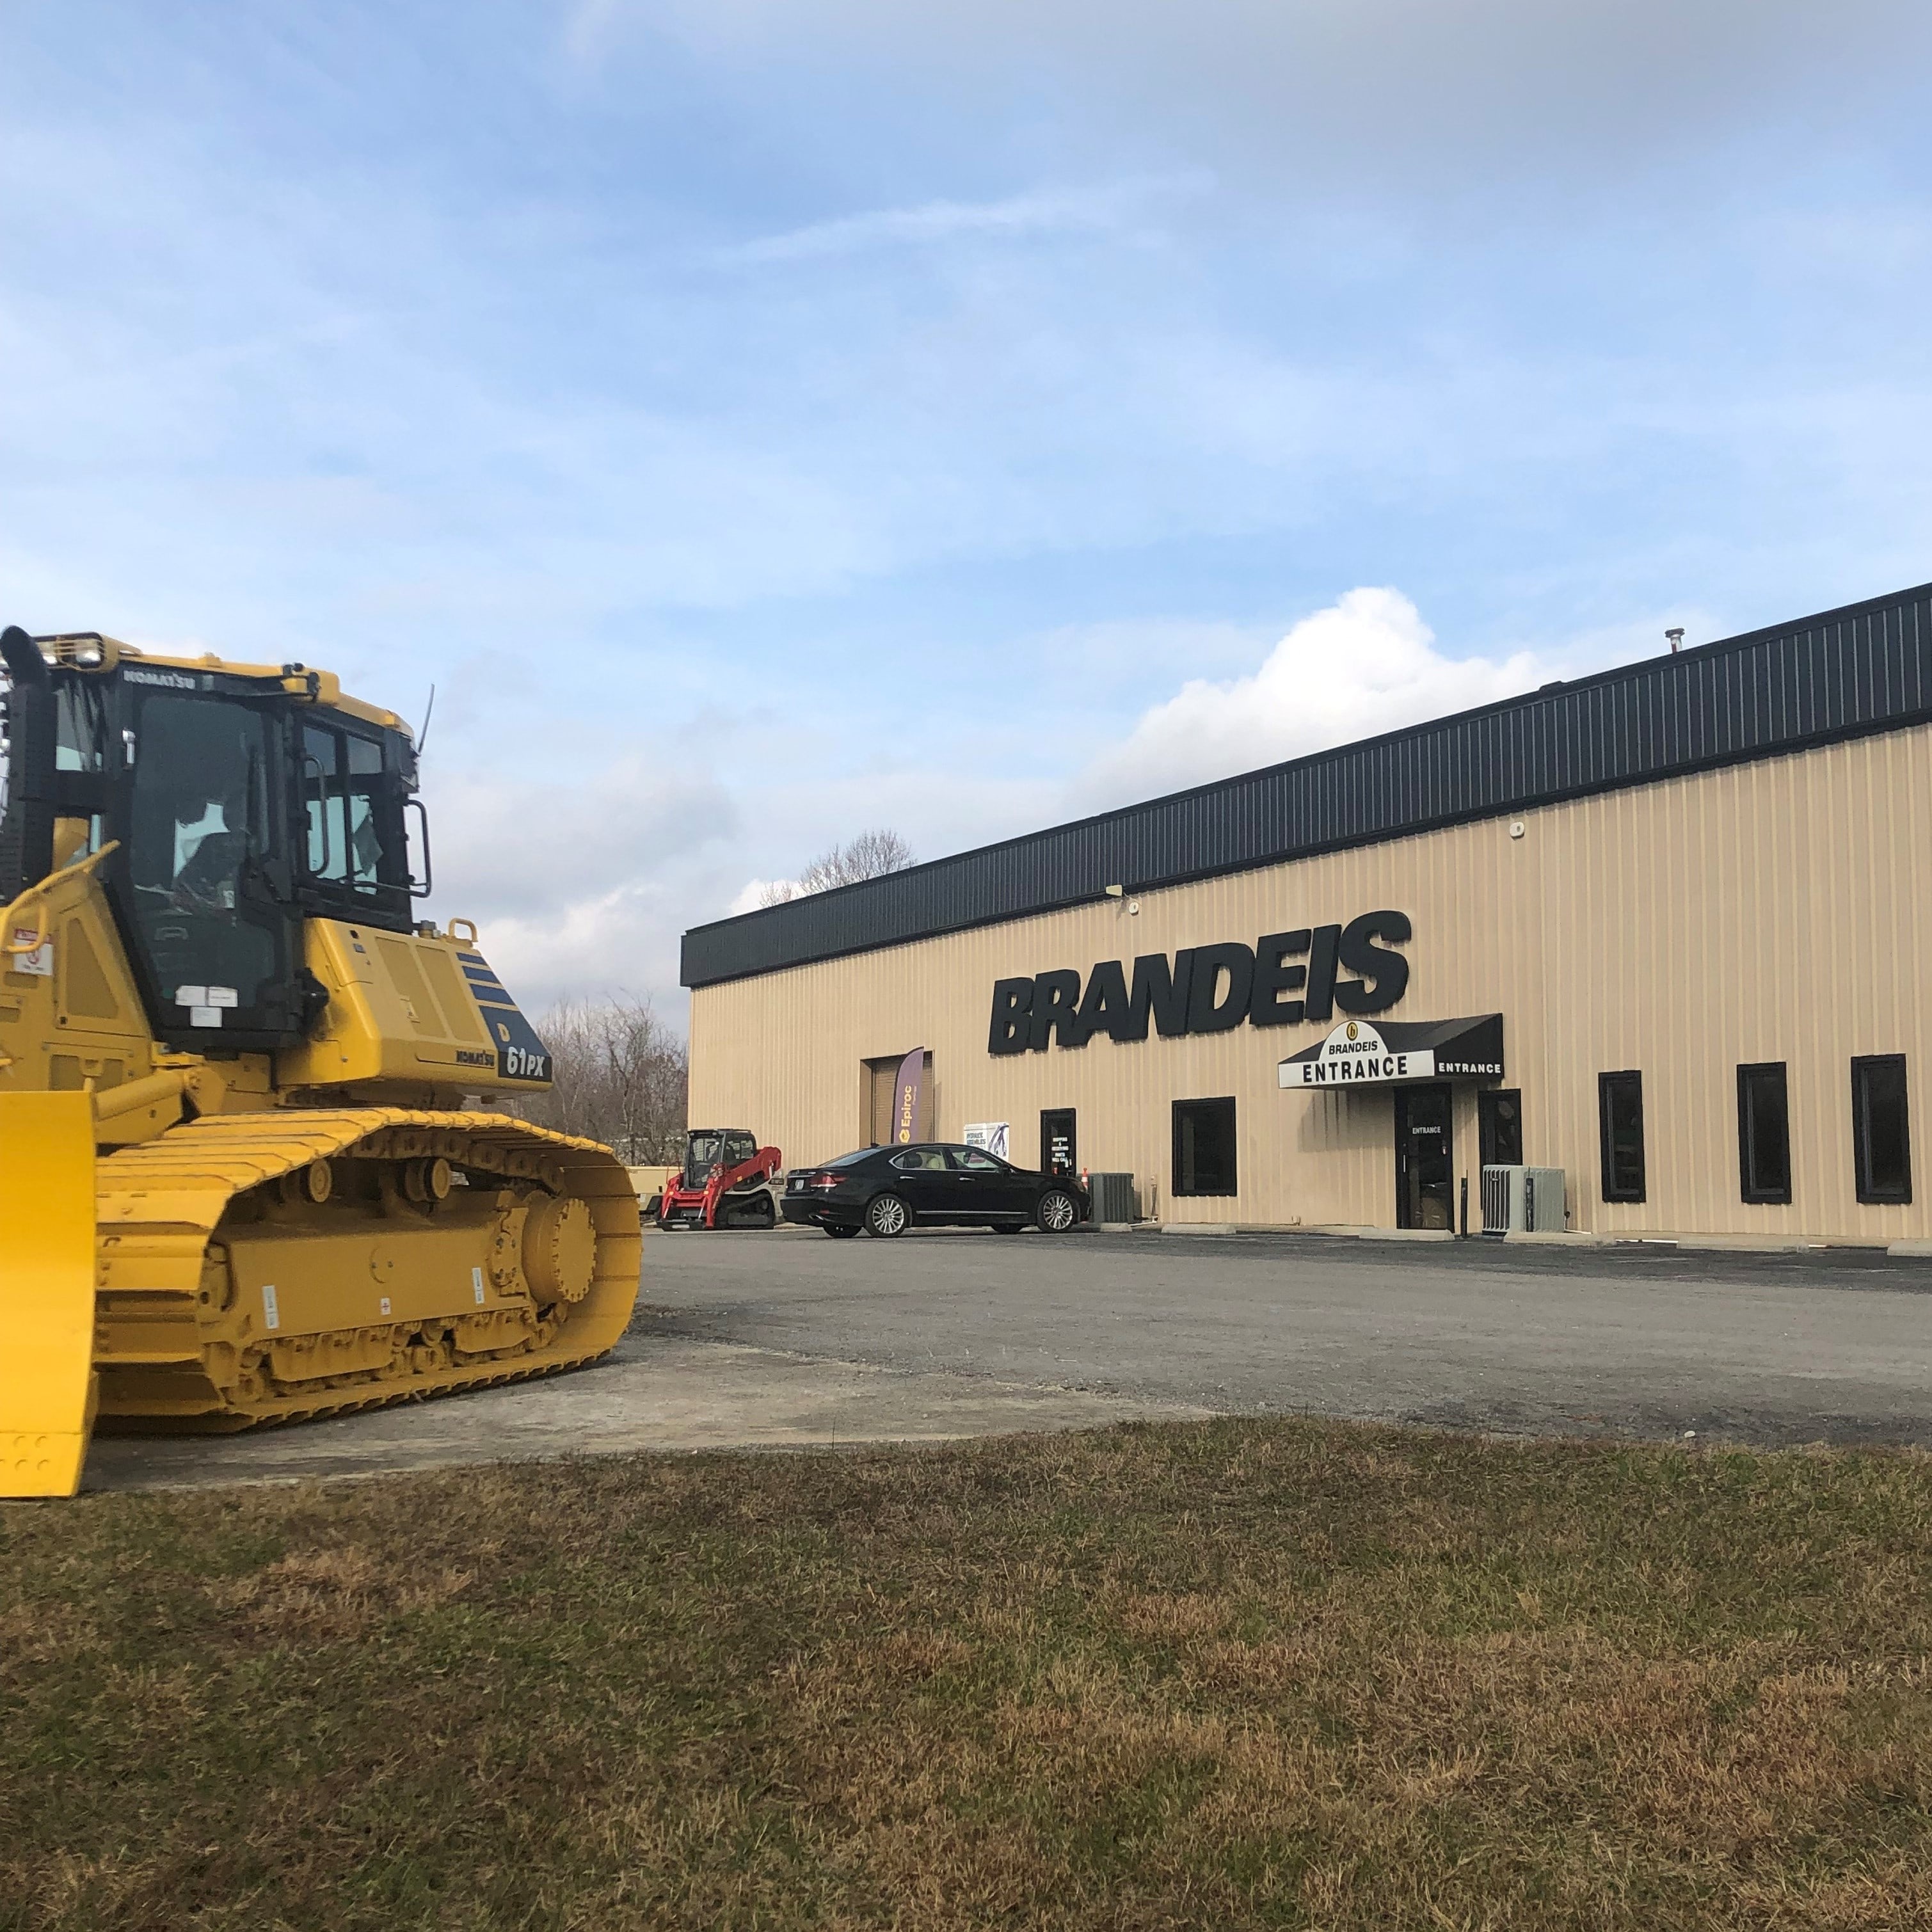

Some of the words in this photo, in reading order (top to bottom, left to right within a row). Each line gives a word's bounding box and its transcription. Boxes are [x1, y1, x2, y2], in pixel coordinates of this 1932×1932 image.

[988, 910, 1412, 1055] BRANDEIS
[497, 1023, 511, 1042] D
[1329, 1041, 1378, 1055] BRANDEIS
[1303, 1056, 1408, 1083] ENTRANCE
[1439, 1062, 1501, 1074] ENTRANCE
[901, 1085, 912, 1126] Epiroc
